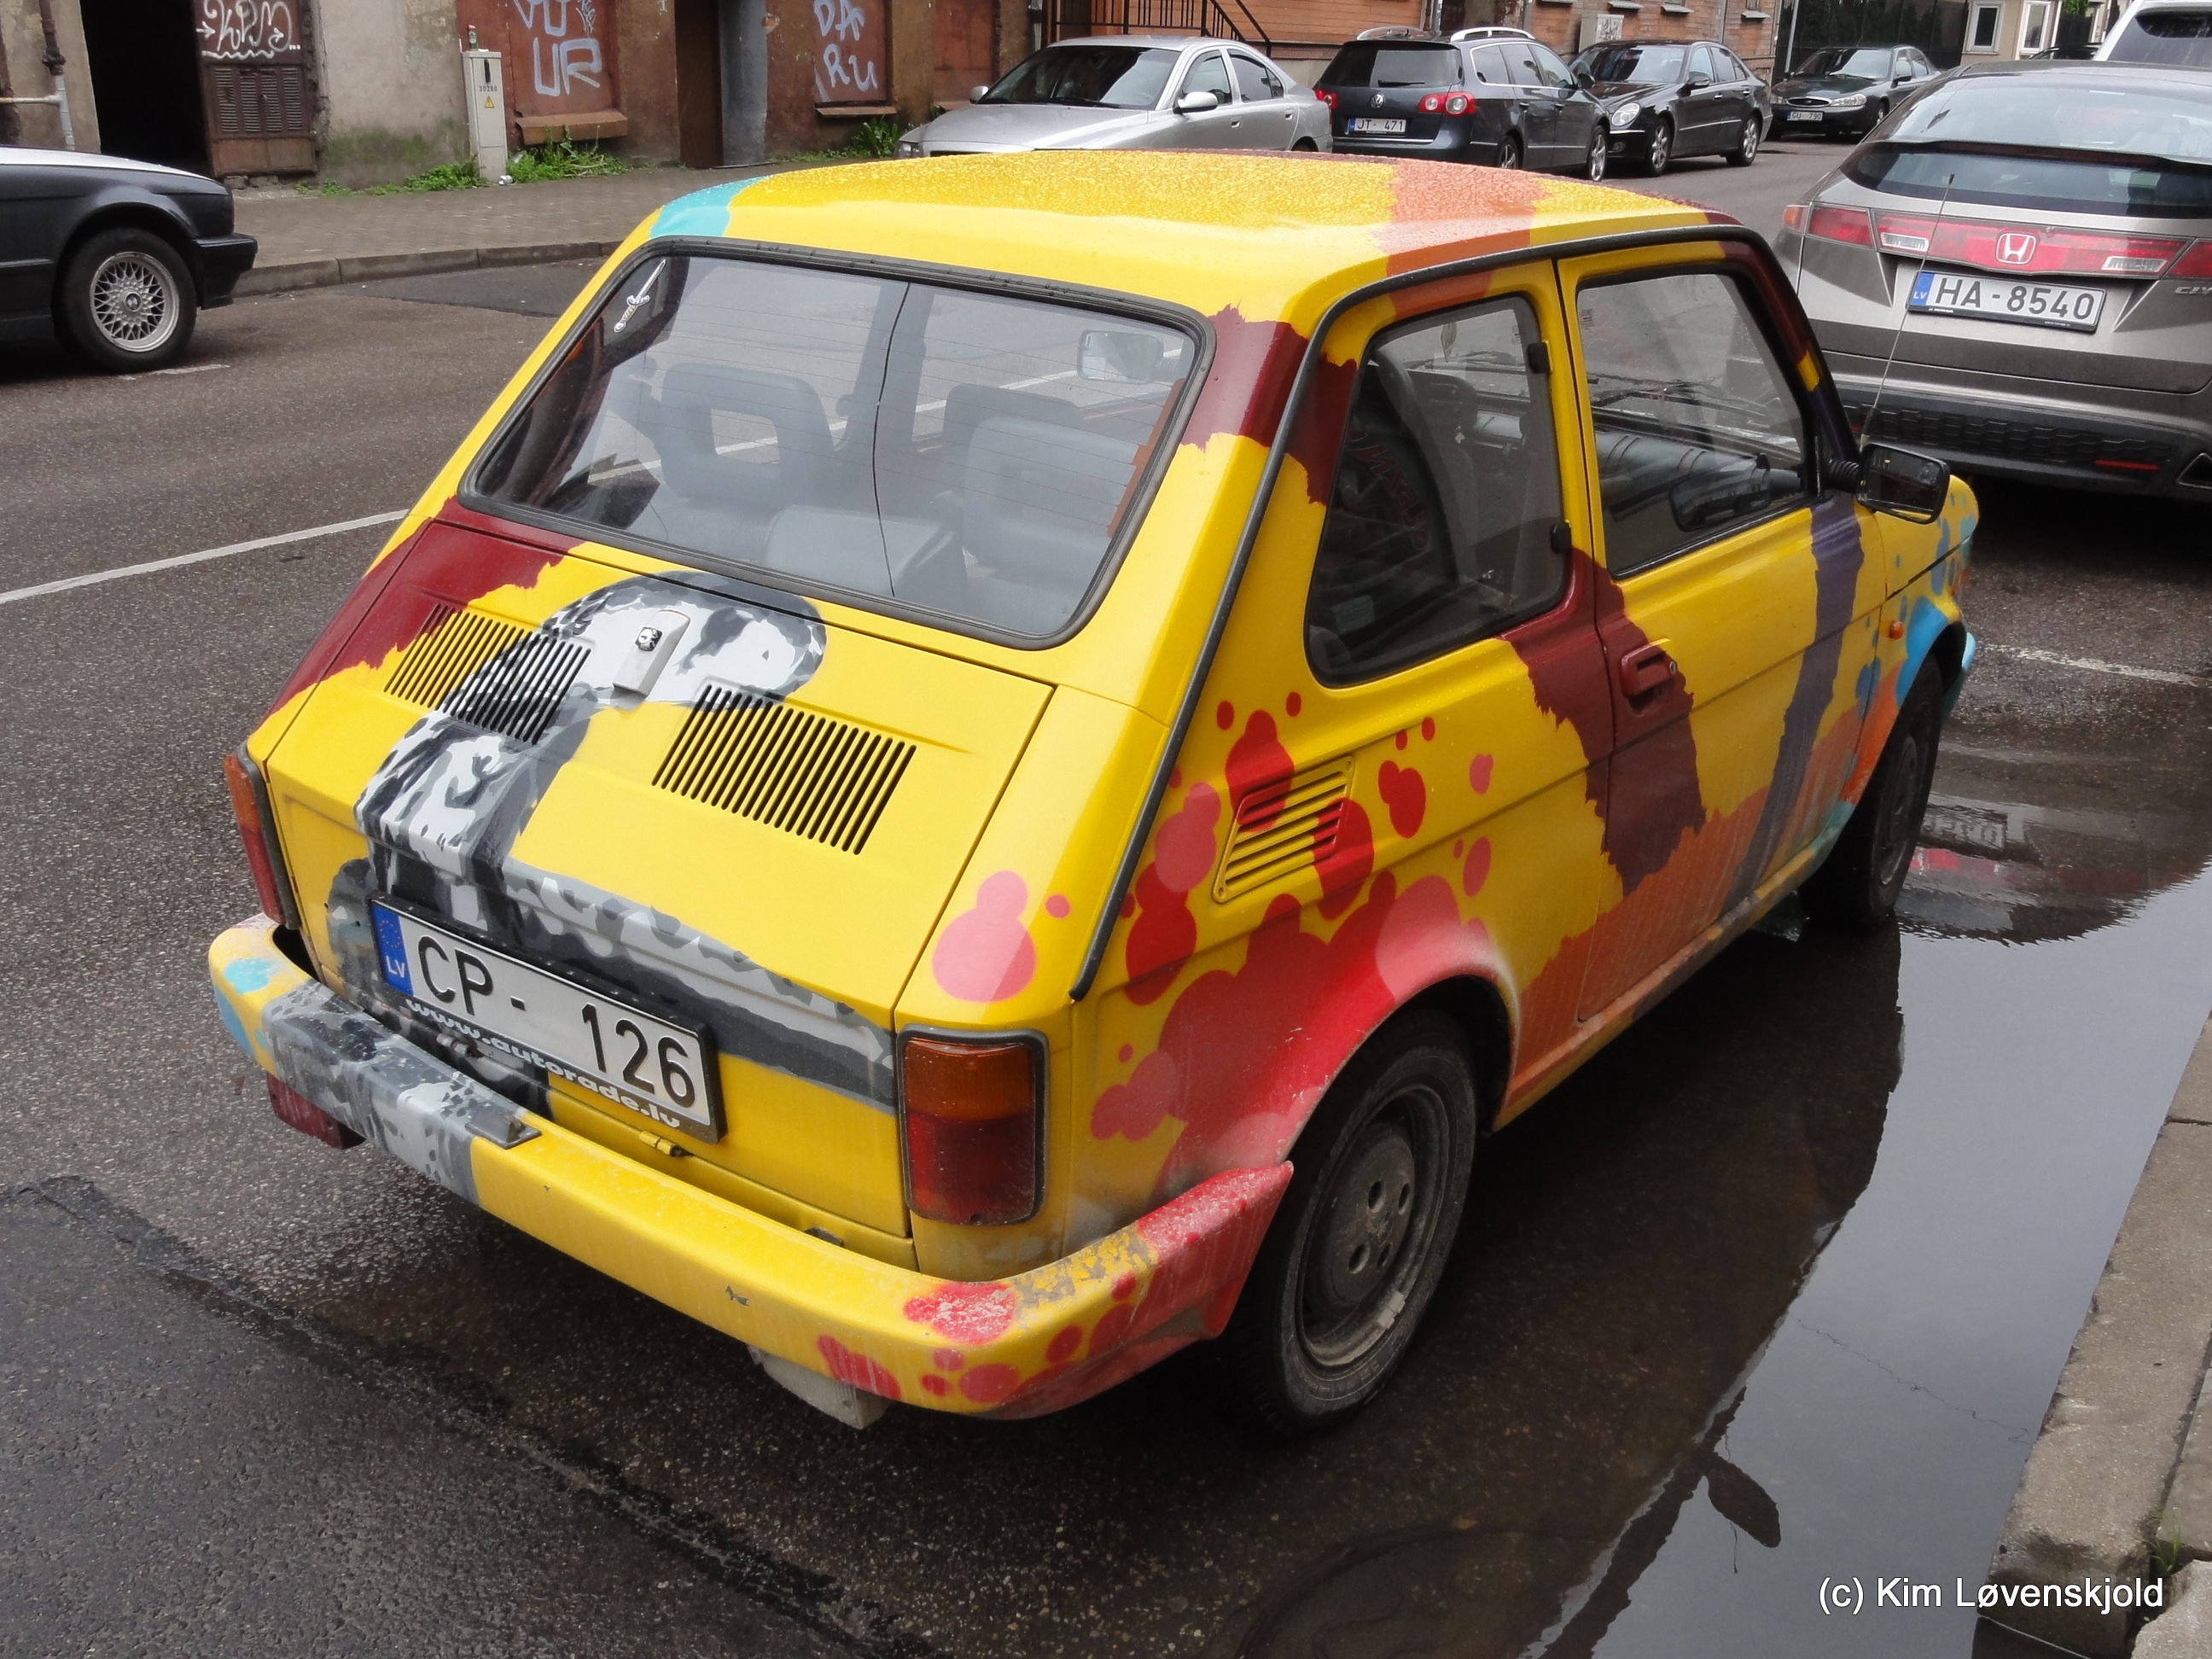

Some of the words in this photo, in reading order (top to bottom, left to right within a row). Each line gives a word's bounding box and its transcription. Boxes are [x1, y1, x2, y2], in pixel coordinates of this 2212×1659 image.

[533, 37, 602, 96] UR
[1384, 121, 1403, 131] 471
[1913, 291, 1927, 300] LV
[386, 955, 405, 978] LV
[405, 998, 680, 1128] www.autorade.lv
[581, 1002, 696, 1108] 126
